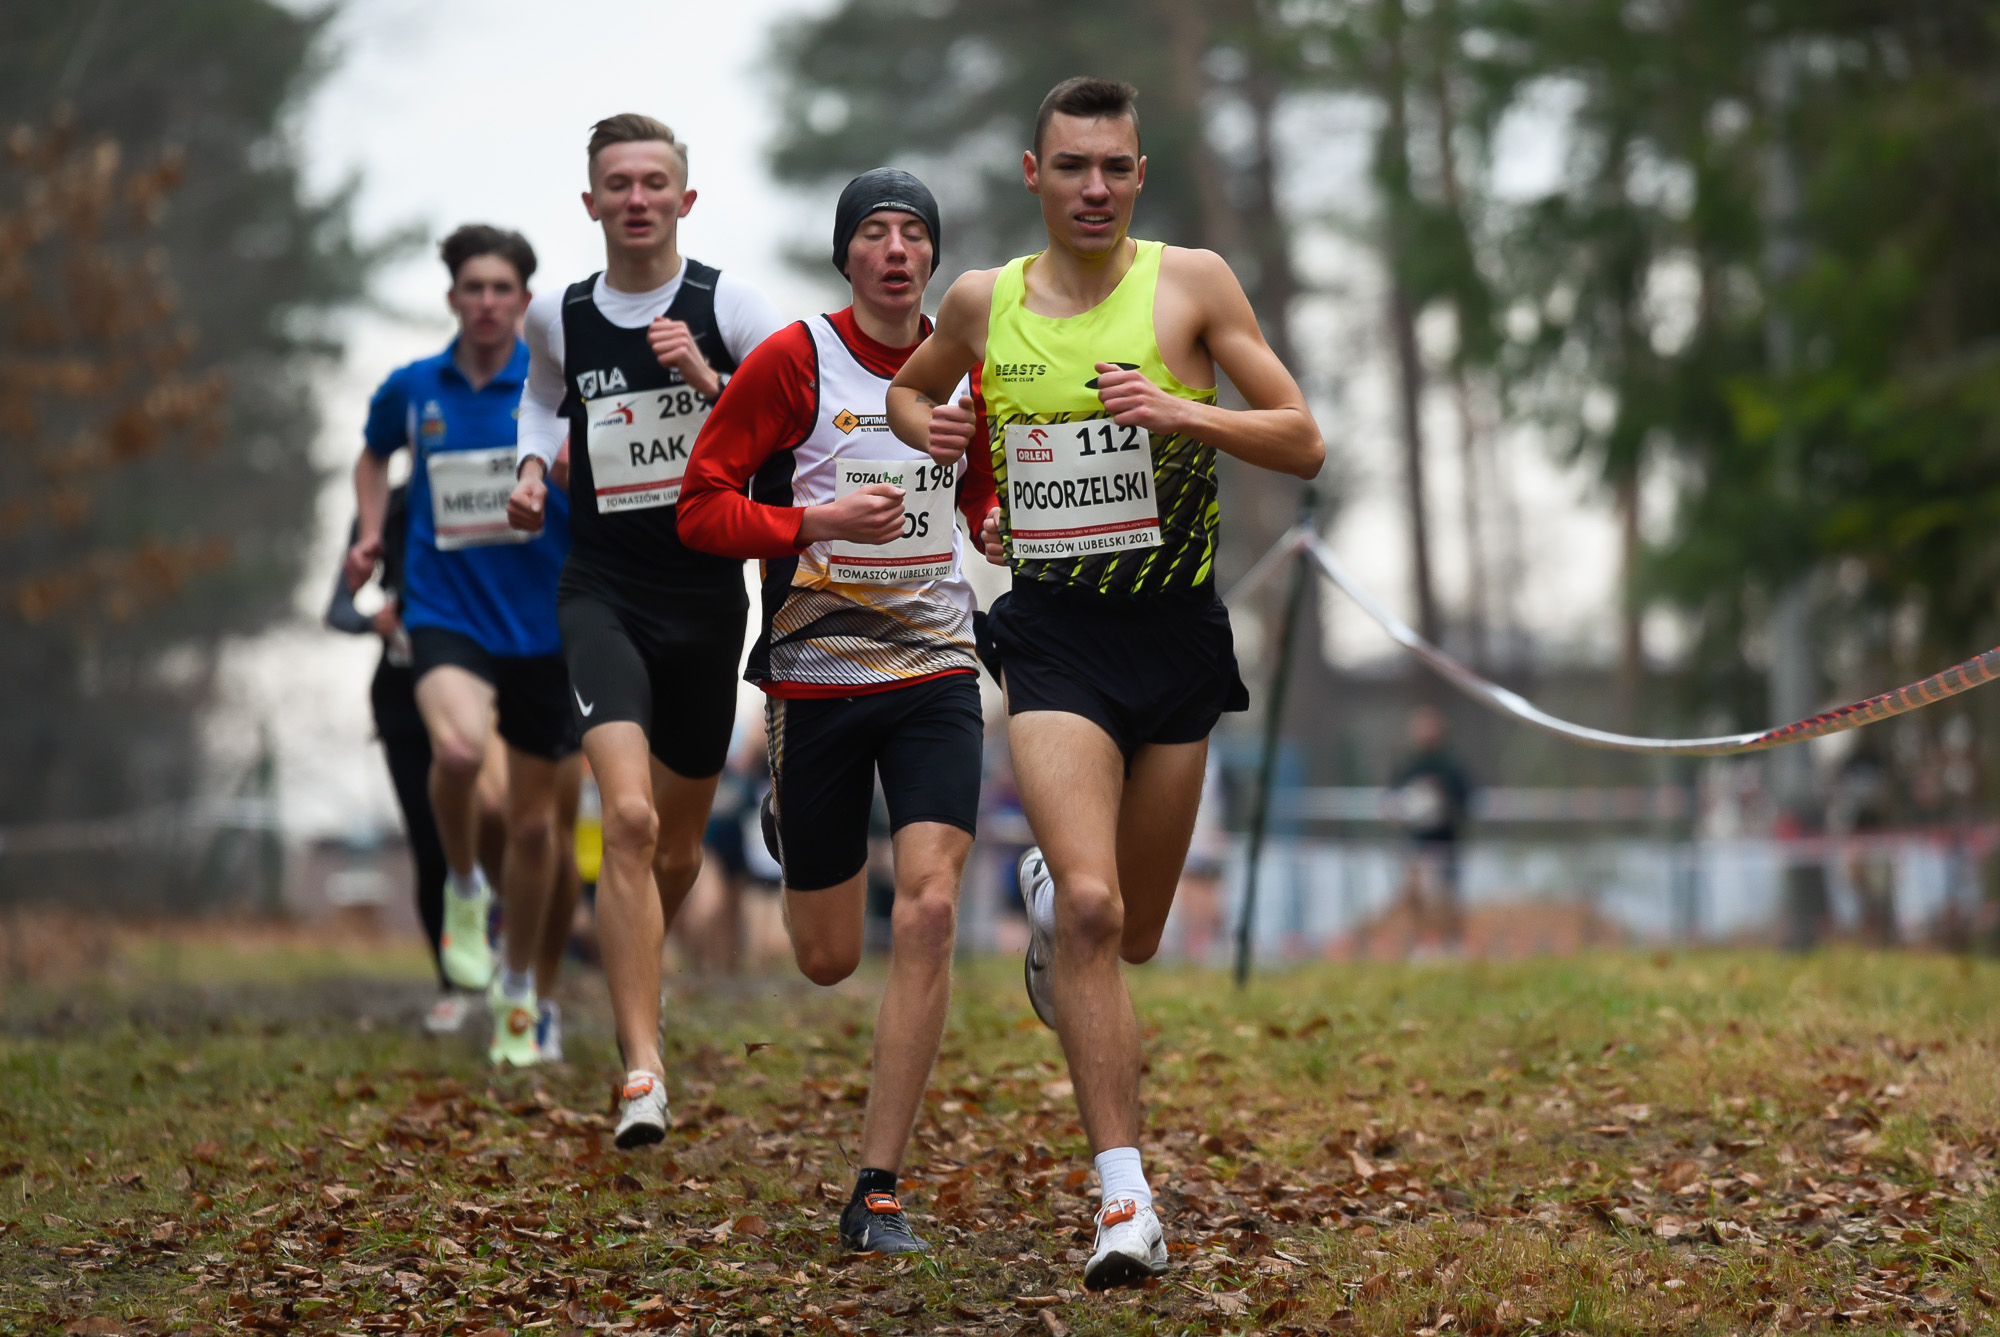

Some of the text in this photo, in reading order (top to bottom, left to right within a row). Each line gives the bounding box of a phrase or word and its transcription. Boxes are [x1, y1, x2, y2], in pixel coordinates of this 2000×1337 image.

[995, 364, 1046, 376] BEASTS
[1076, 425, 1140, 457] 112
[629, 434, 688, 467] RAK
[1018, 450, 1050, 461] ORLEN
[846, 472, 904, 484] TOTALbet
[915, 464, 954, 492] 198
[606, 492, 660, 507] TOMASZÓW
[1013, 471, 1148, 510] POGORZELSKI
[1018, 532, 1154, 553] TOMASZÓW LUBELSKI 2021
[837, 566, 950, 580] TOMASZÓW LUBELSKI 2021
